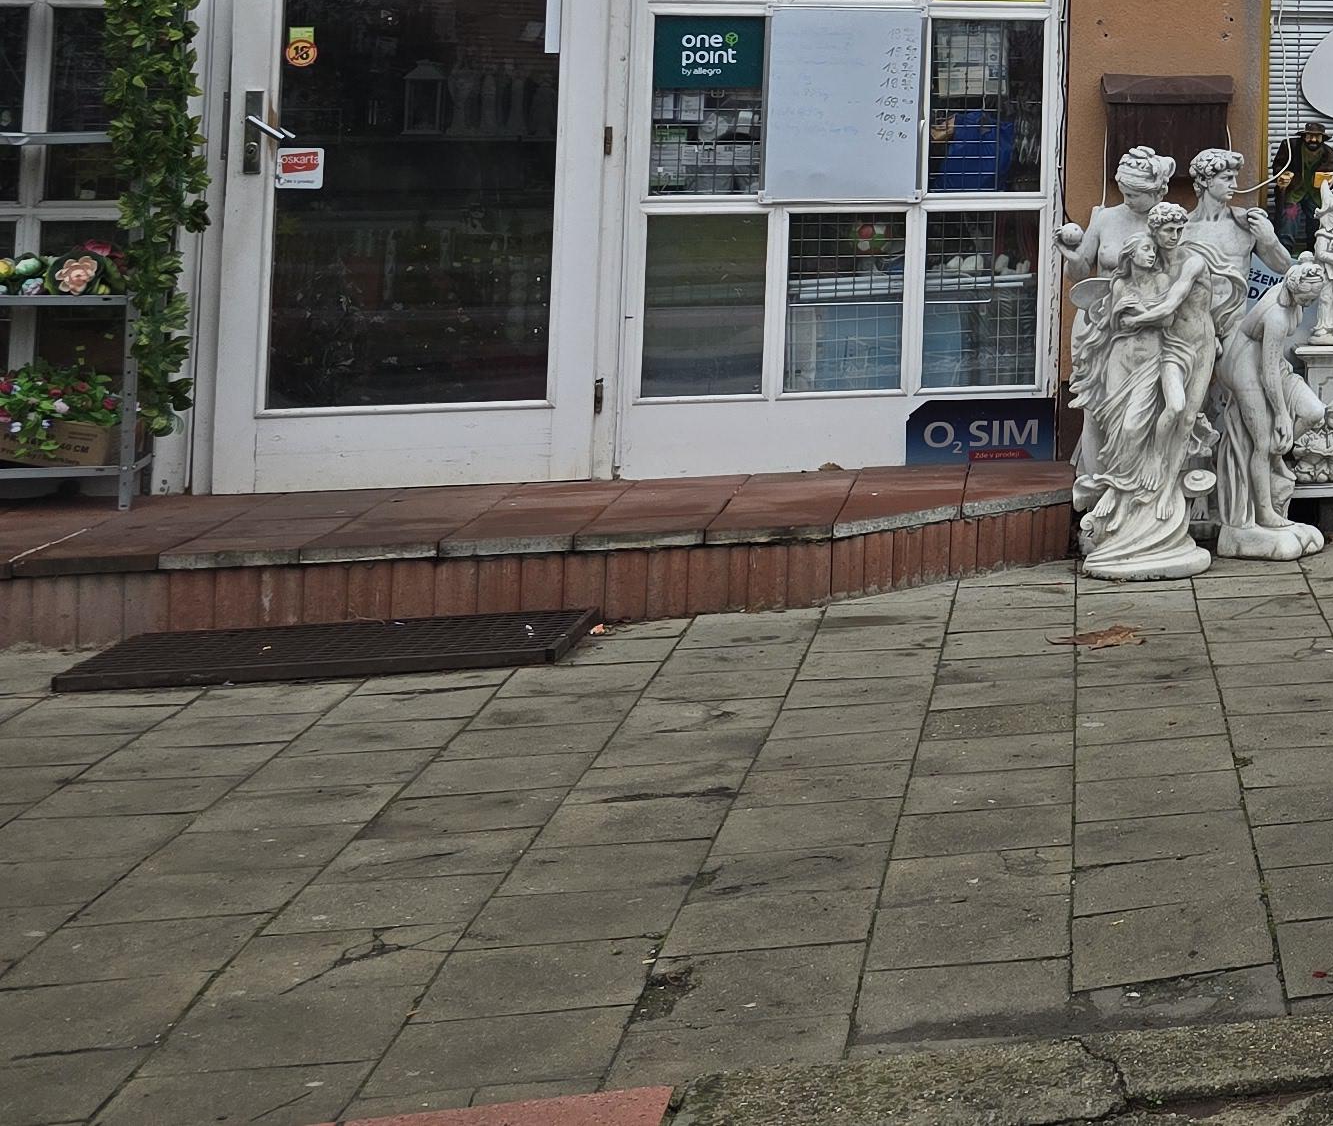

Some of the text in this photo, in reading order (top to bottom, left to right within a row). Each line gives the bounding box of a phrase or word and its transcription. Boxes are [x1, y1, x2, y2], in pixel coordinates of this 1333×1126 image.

[682, 34, 723, 47] one
[293, 45, 310, 61] 18
[682, 48, 737, 66] point
[682, 68, 722, 76] by allegro
[969, 418, 1039, 447] SIM
